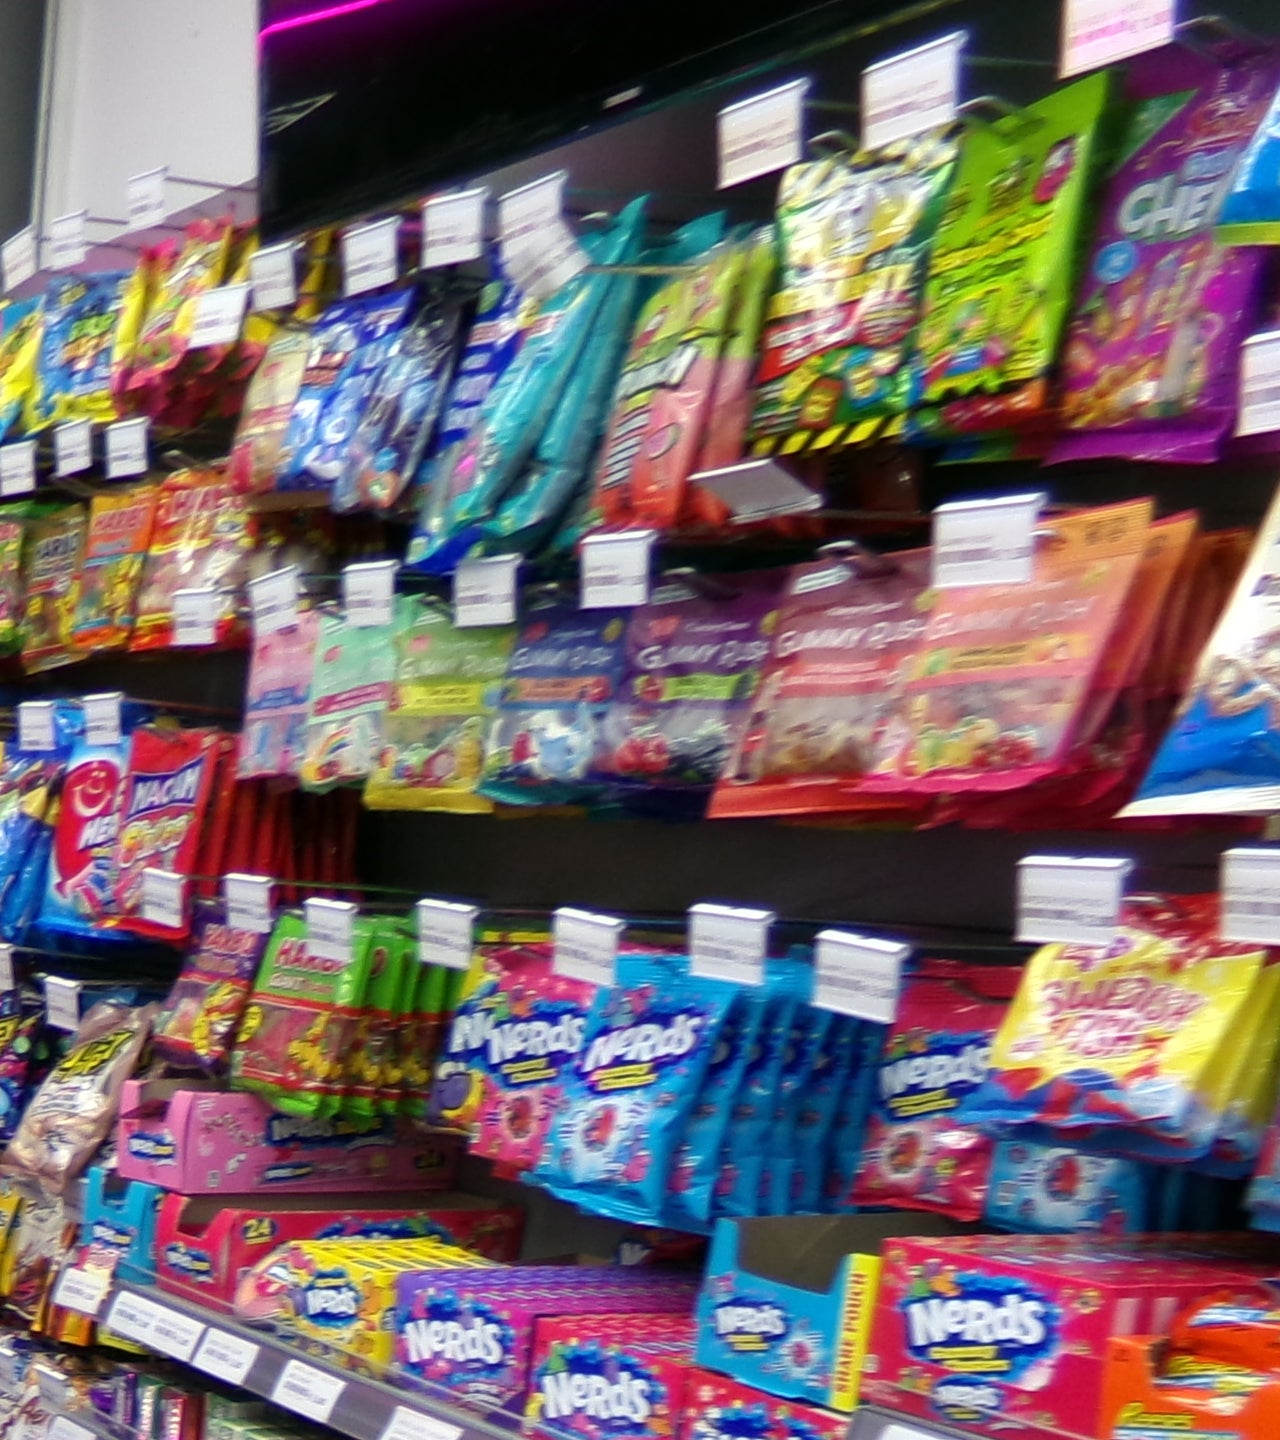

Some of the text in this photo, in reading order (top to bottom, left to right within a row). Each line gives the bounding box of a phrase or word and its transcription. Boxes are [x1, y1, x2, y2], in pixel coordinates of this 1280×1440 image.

[928, 595, 1096, 640] GUMMY RUSH
[775, 625, 870, 659] GUMMY
[245, 1220, 274, 1240] 24
